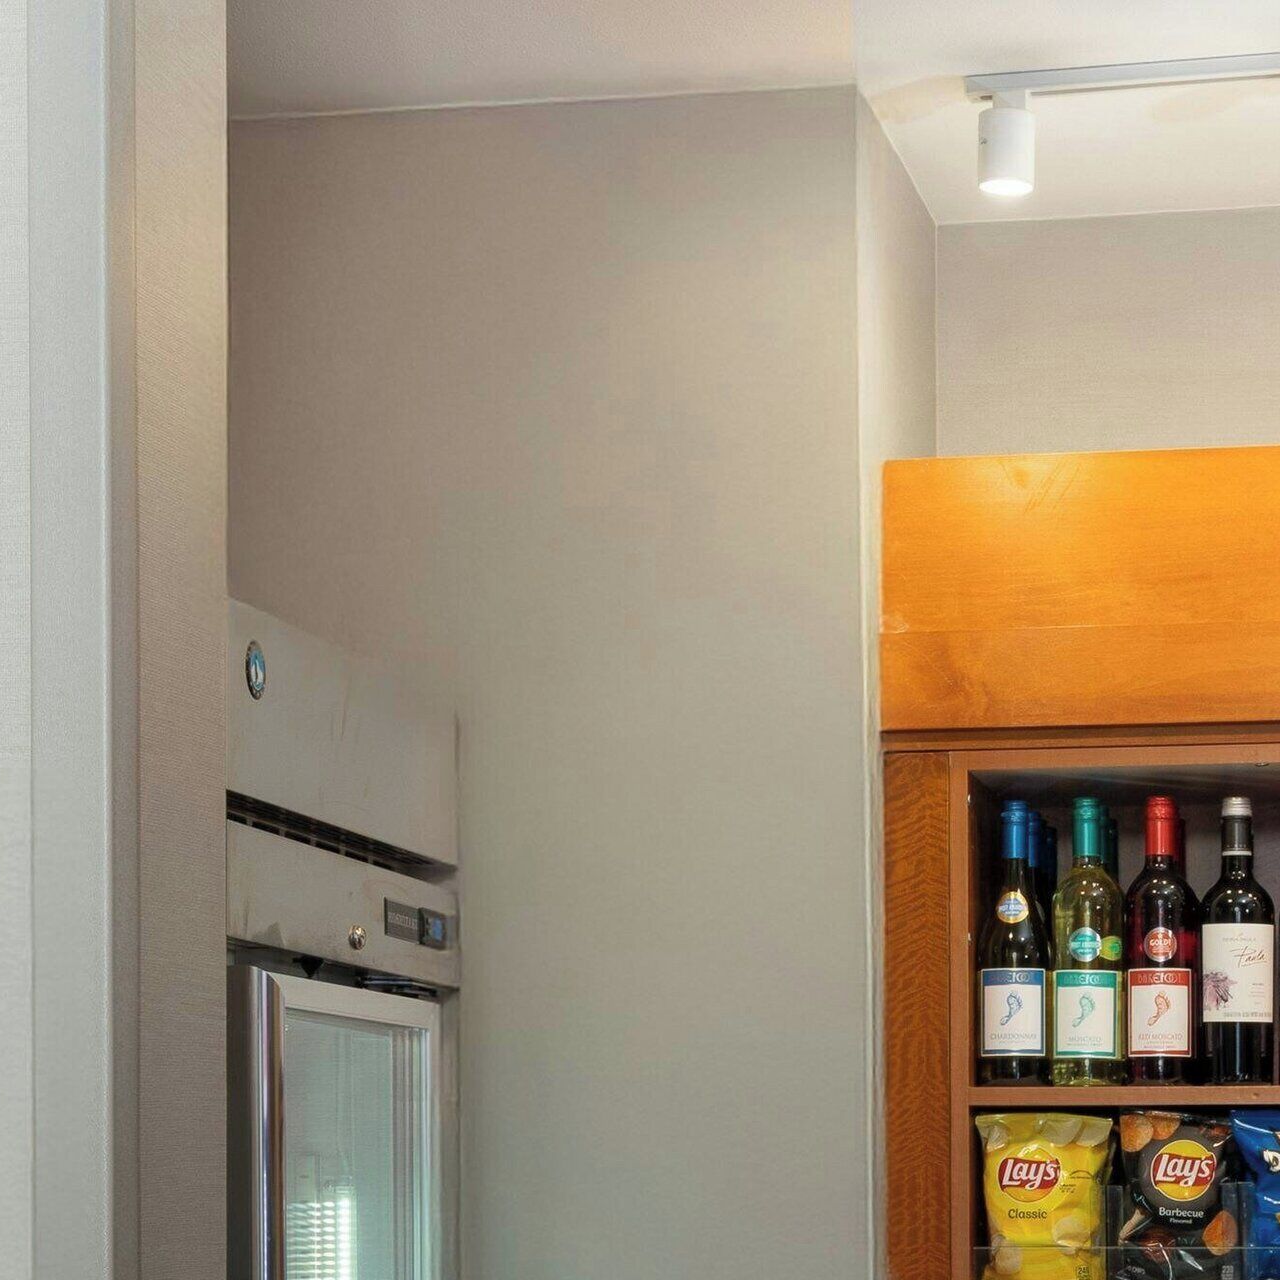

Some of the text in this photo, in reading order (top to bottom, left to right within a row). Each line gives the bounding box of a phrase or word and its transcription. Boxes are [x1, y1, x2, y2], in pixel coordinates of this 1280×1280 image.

[1002, 1159, 1058, 1190] Lay's
[1155, 1154, 1214, 1187] Lay's
[1008, 1208, 1048, 1219] Classic
[1159, 1207, 1204, 1219] Barbecue
